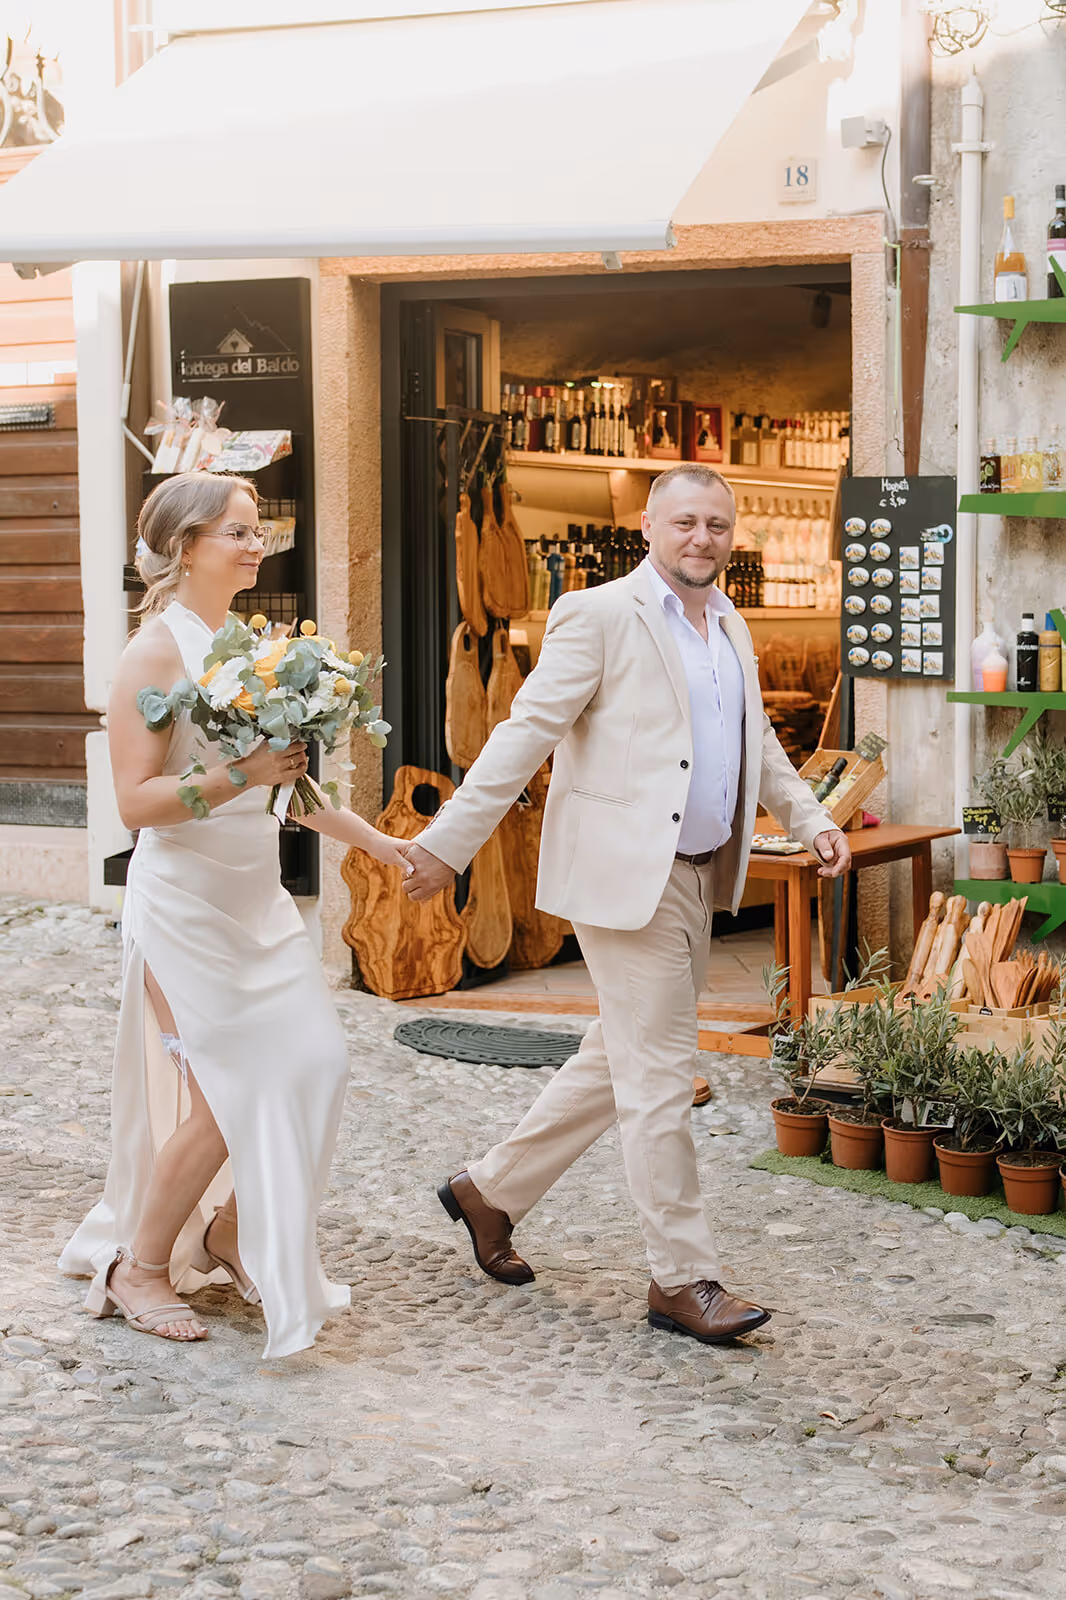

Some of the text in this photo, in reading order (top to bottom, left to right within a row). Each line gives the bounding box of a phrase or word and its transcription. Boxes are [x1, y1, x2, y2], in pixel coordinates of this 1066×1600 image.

[784, 165, 809, 187] 18
[231, 358, 252, 374] del
[256, 357, 300, 374] Baldo
